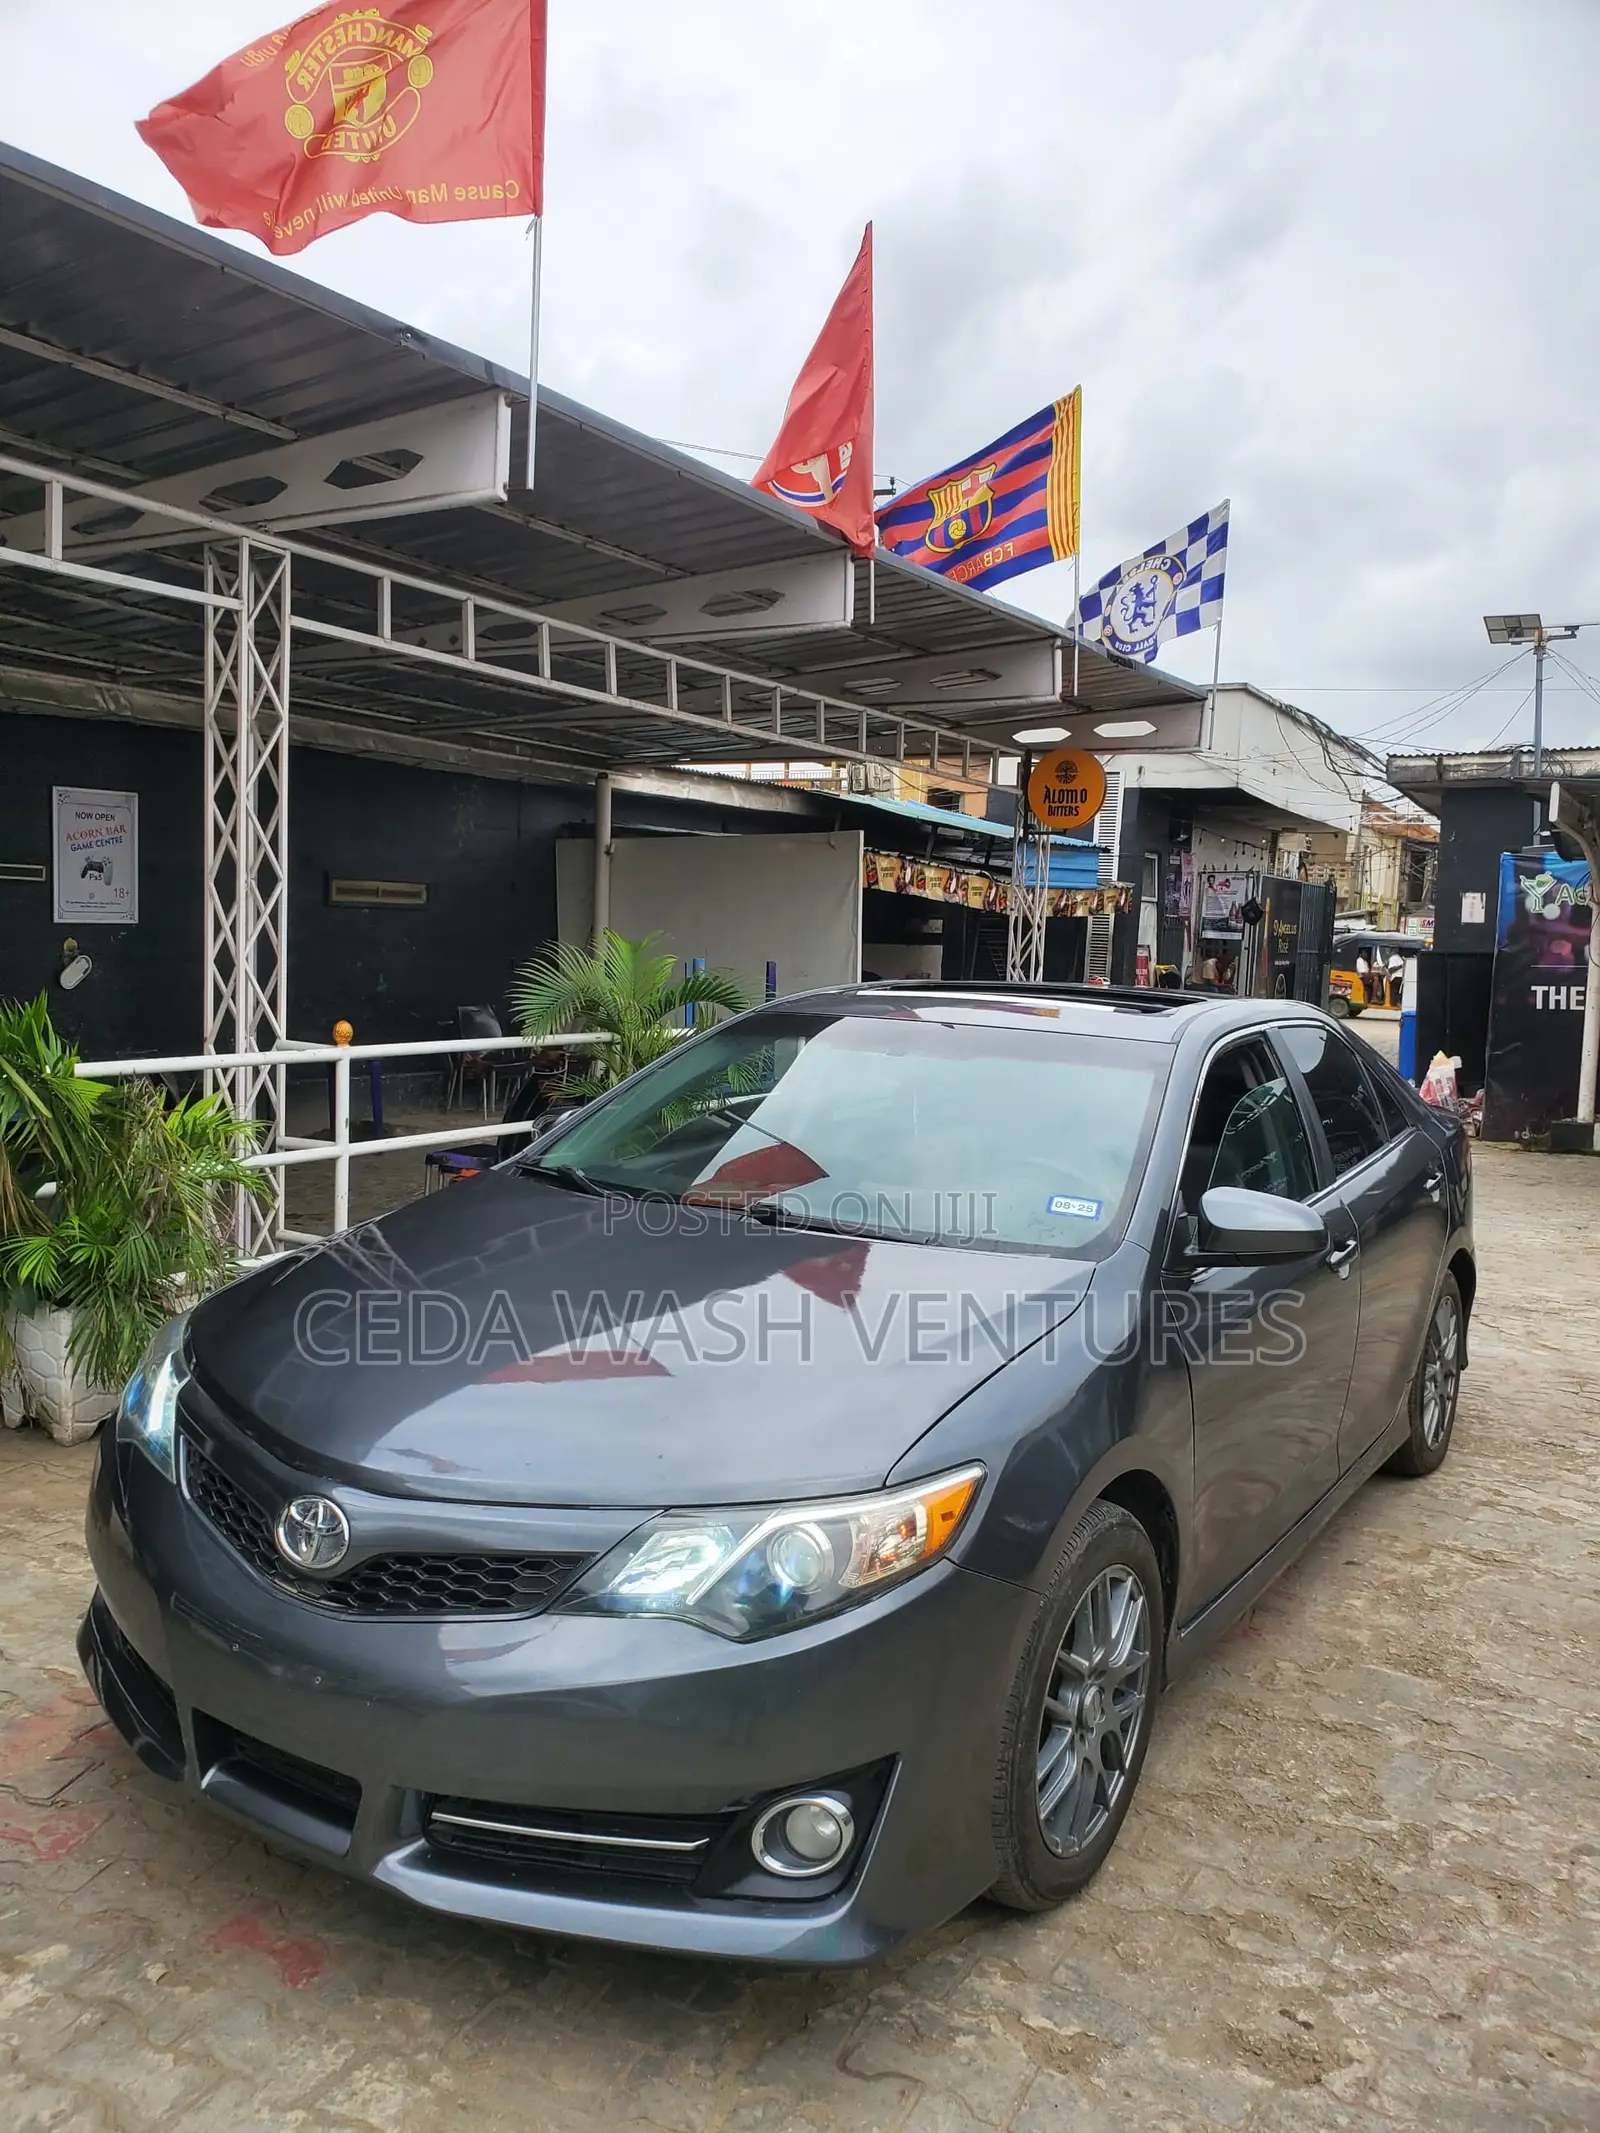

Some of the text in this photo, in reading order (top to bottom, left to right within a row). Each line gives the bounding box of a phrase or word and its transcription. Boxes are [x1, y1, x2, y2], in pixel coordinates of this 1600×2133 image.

[75, 811, 115, 822] NOW OPEN
[66, 828, 103, 842] ACORN
[70, 835, 123, 852] GAME CENTRE
[114, 887, 130, 899] 18+
[1531, 985, 1585, 1010] THE
